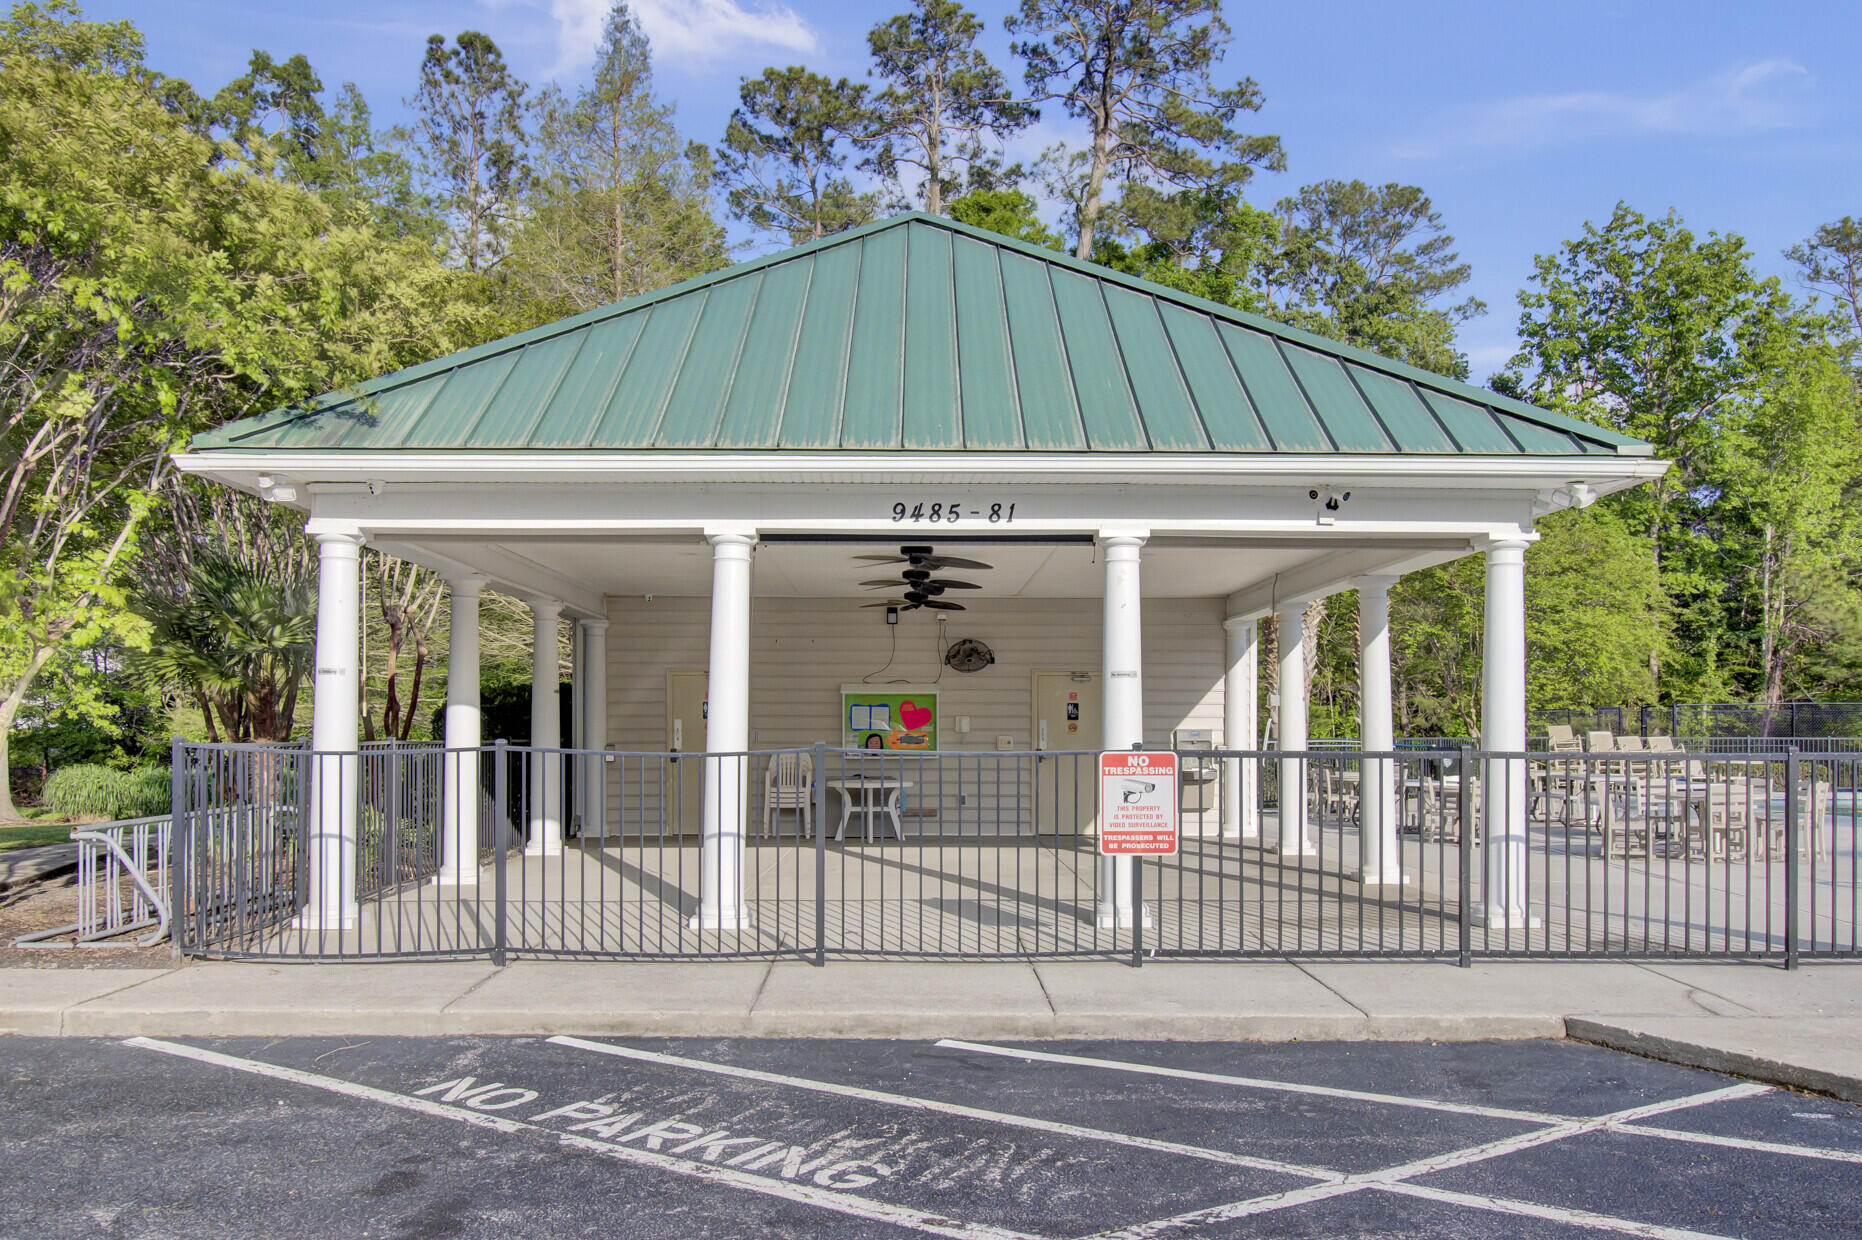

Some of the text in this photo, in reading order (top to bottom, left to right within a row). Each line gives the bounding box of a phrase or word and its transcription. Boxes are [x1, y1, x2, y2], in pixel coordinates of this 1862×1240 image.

[892, 502, 1015, 523] 9485-81
[1127, 755, 1149, 766] NO
[1103, 767, 1174, 775] TRESPASSING
[413, 1076, 539, 1110] NO
[527, 1101, 892, 1189] PARKING
